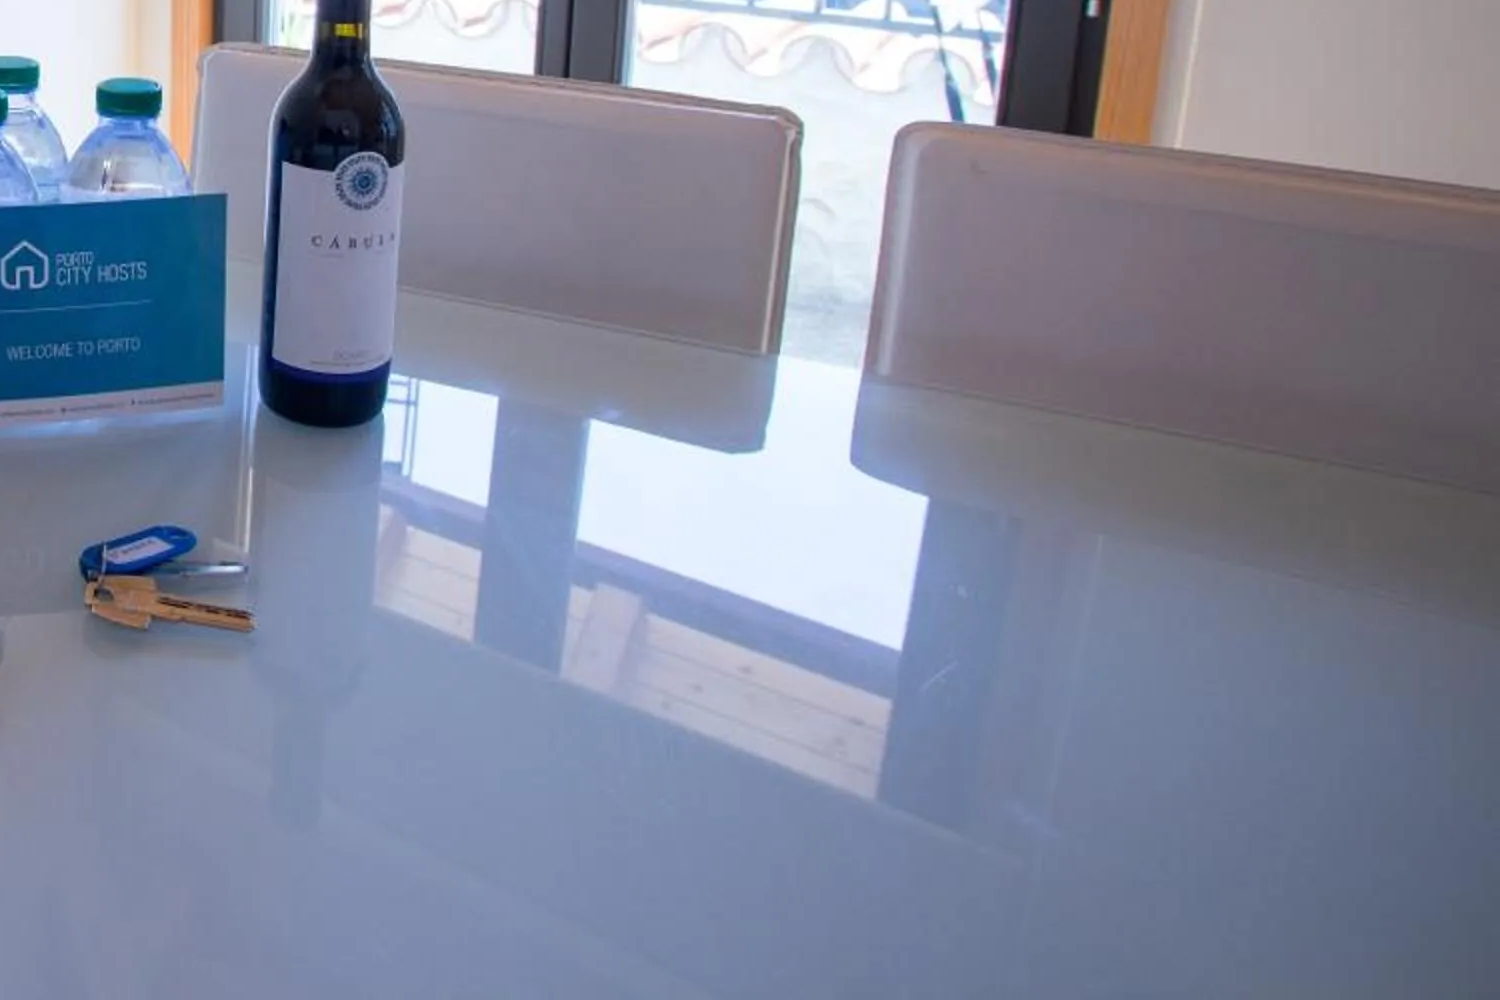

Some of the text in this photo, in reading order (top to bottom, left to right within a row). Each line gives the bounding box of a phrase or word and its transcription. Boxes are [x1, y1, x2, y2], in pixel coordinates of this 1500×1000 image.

[56, 251, 94, 267] PORTO
[56, 261, 147, 286] CITY HOSTS
[6, 337, 141, 361] WELCOME TO PORTO
